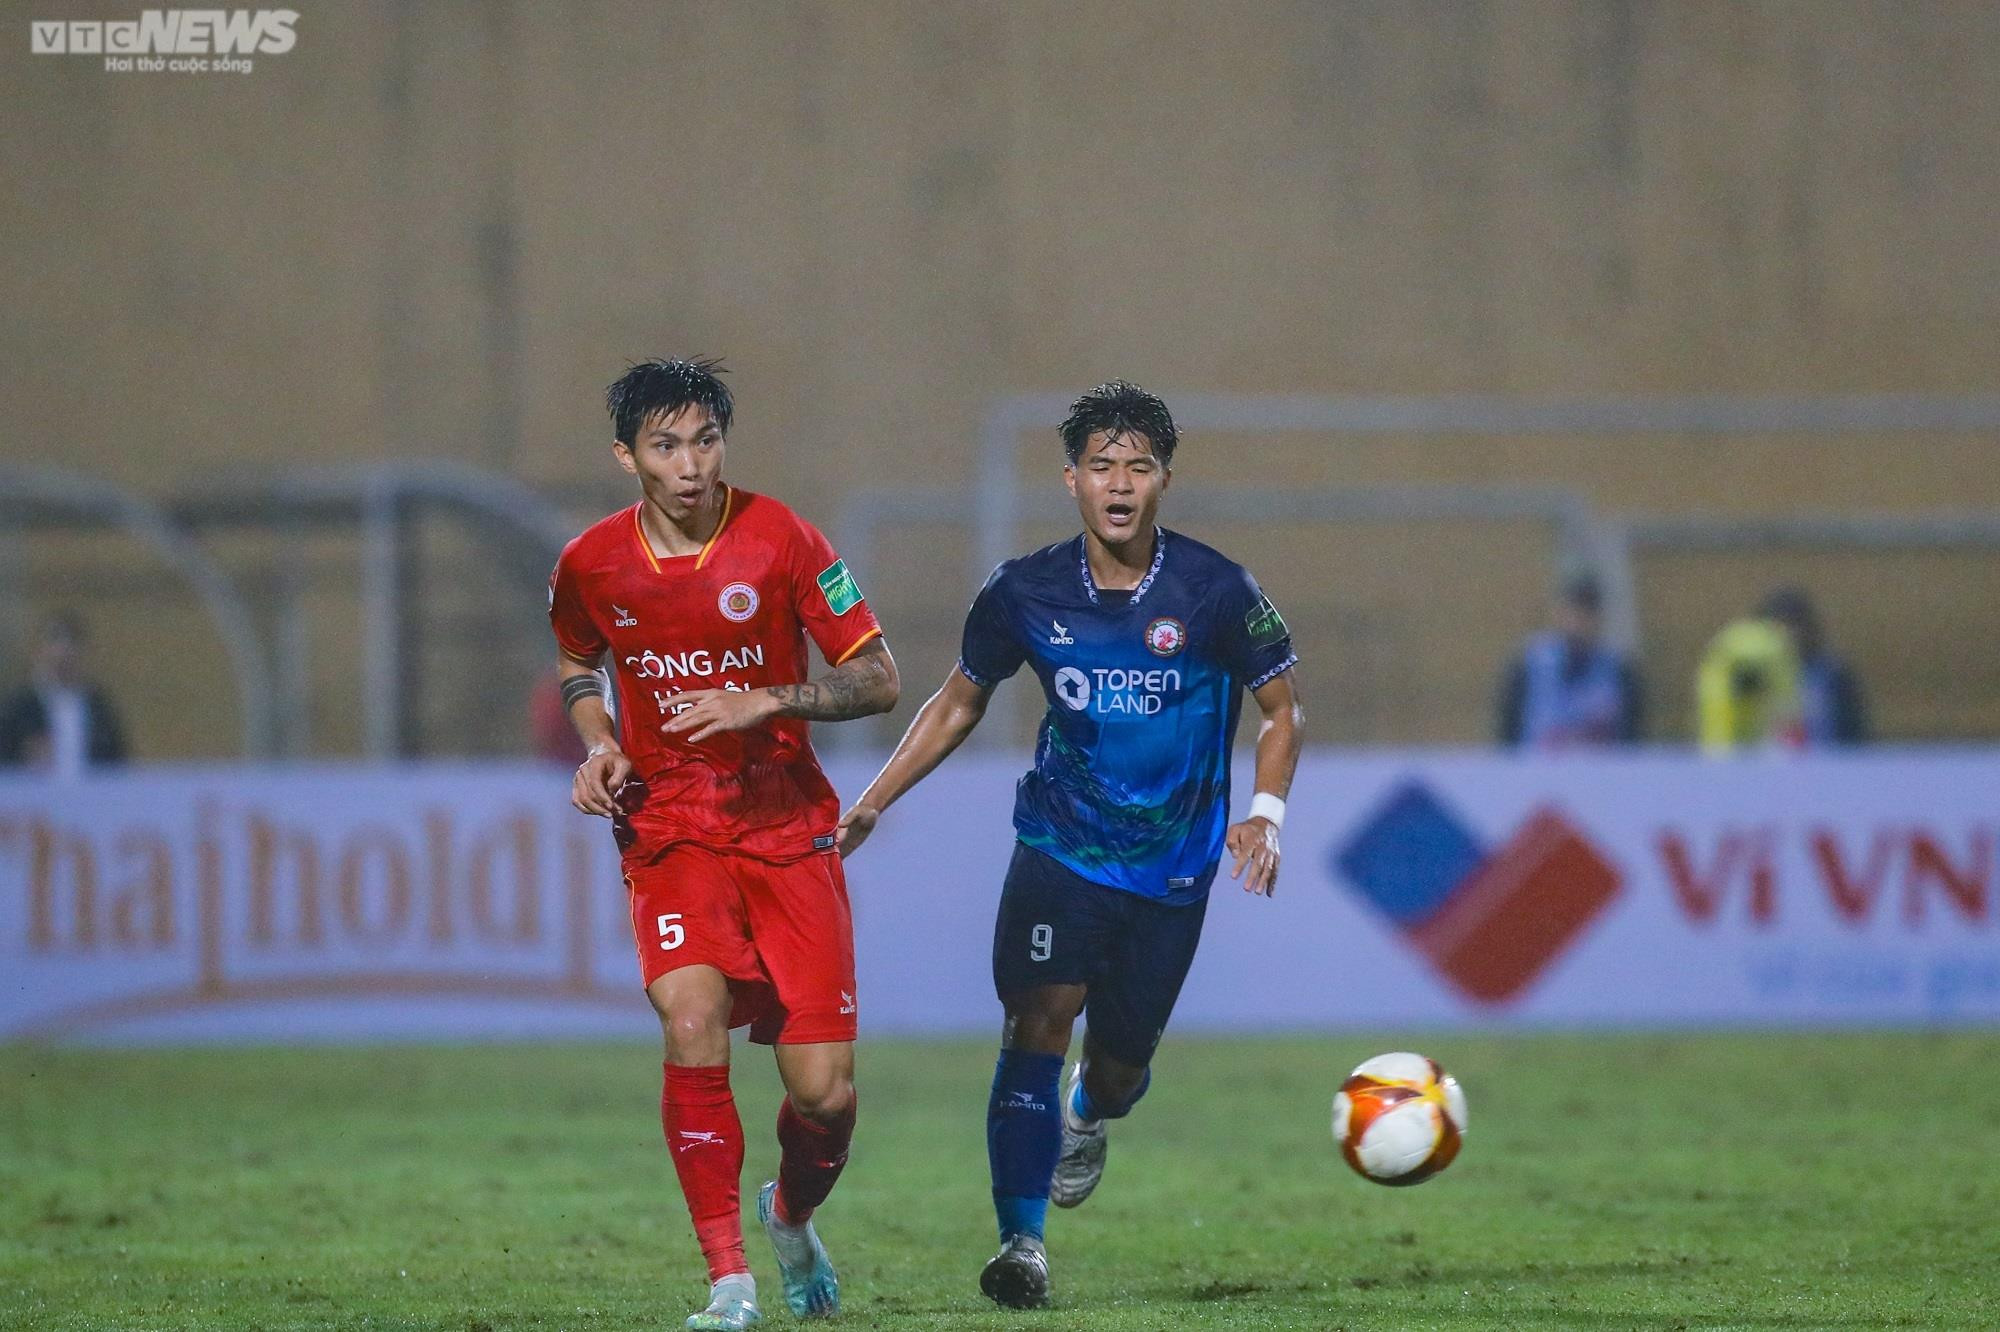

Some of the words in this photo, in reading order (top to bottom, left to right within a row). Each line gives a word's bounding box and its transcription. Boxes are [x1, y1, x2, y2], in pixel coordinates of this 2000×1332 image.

[625, 649, 714, 679] CÔNG
[720, 644, 764, 673] AN
[1092, 668, 1180, 692] TOPEN
[1097, 693, 1161, 715] LAND
[657, 913, 685, 951] 5
[1030, 923, 1053, 962] 9
